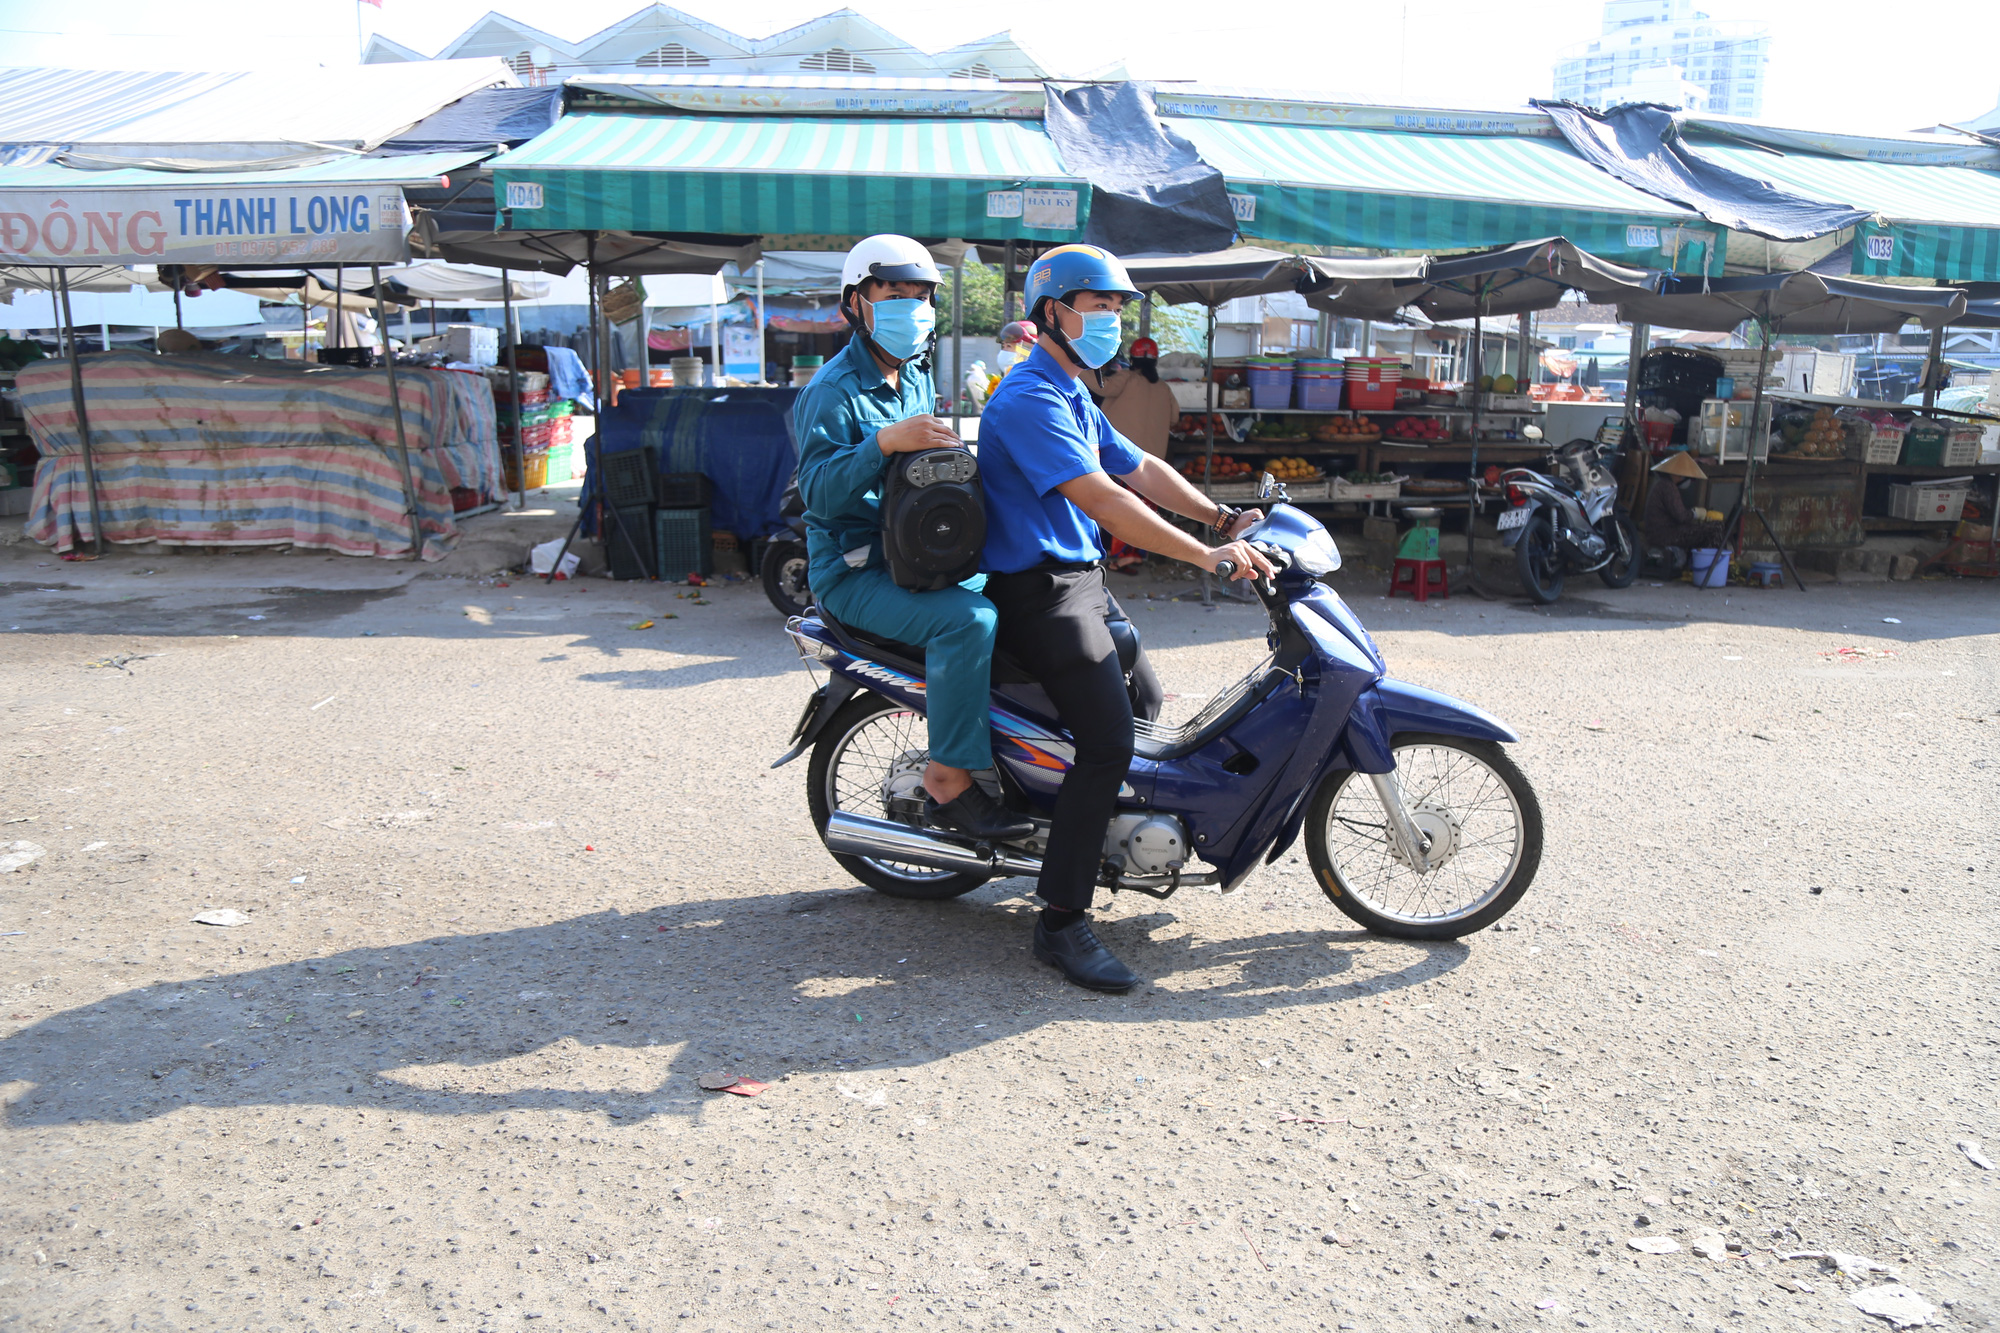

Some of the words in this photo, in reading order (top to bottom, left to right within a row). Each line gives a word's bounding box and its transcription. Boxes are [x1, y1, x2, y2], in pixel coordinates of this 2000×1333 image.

[174, 197, 276, 236] THANH
[289, 194, 370, 234] LONG
[1228, 196, 1255, 218] D37
[0, 198, 168, 256] ĐÔNG
[215, 241, 237, 256] ĐT:
[241, 240, 277, 256] 0975
[281, 240, 307, 255] 252
[1868, 238, 1893, 258] KD33
